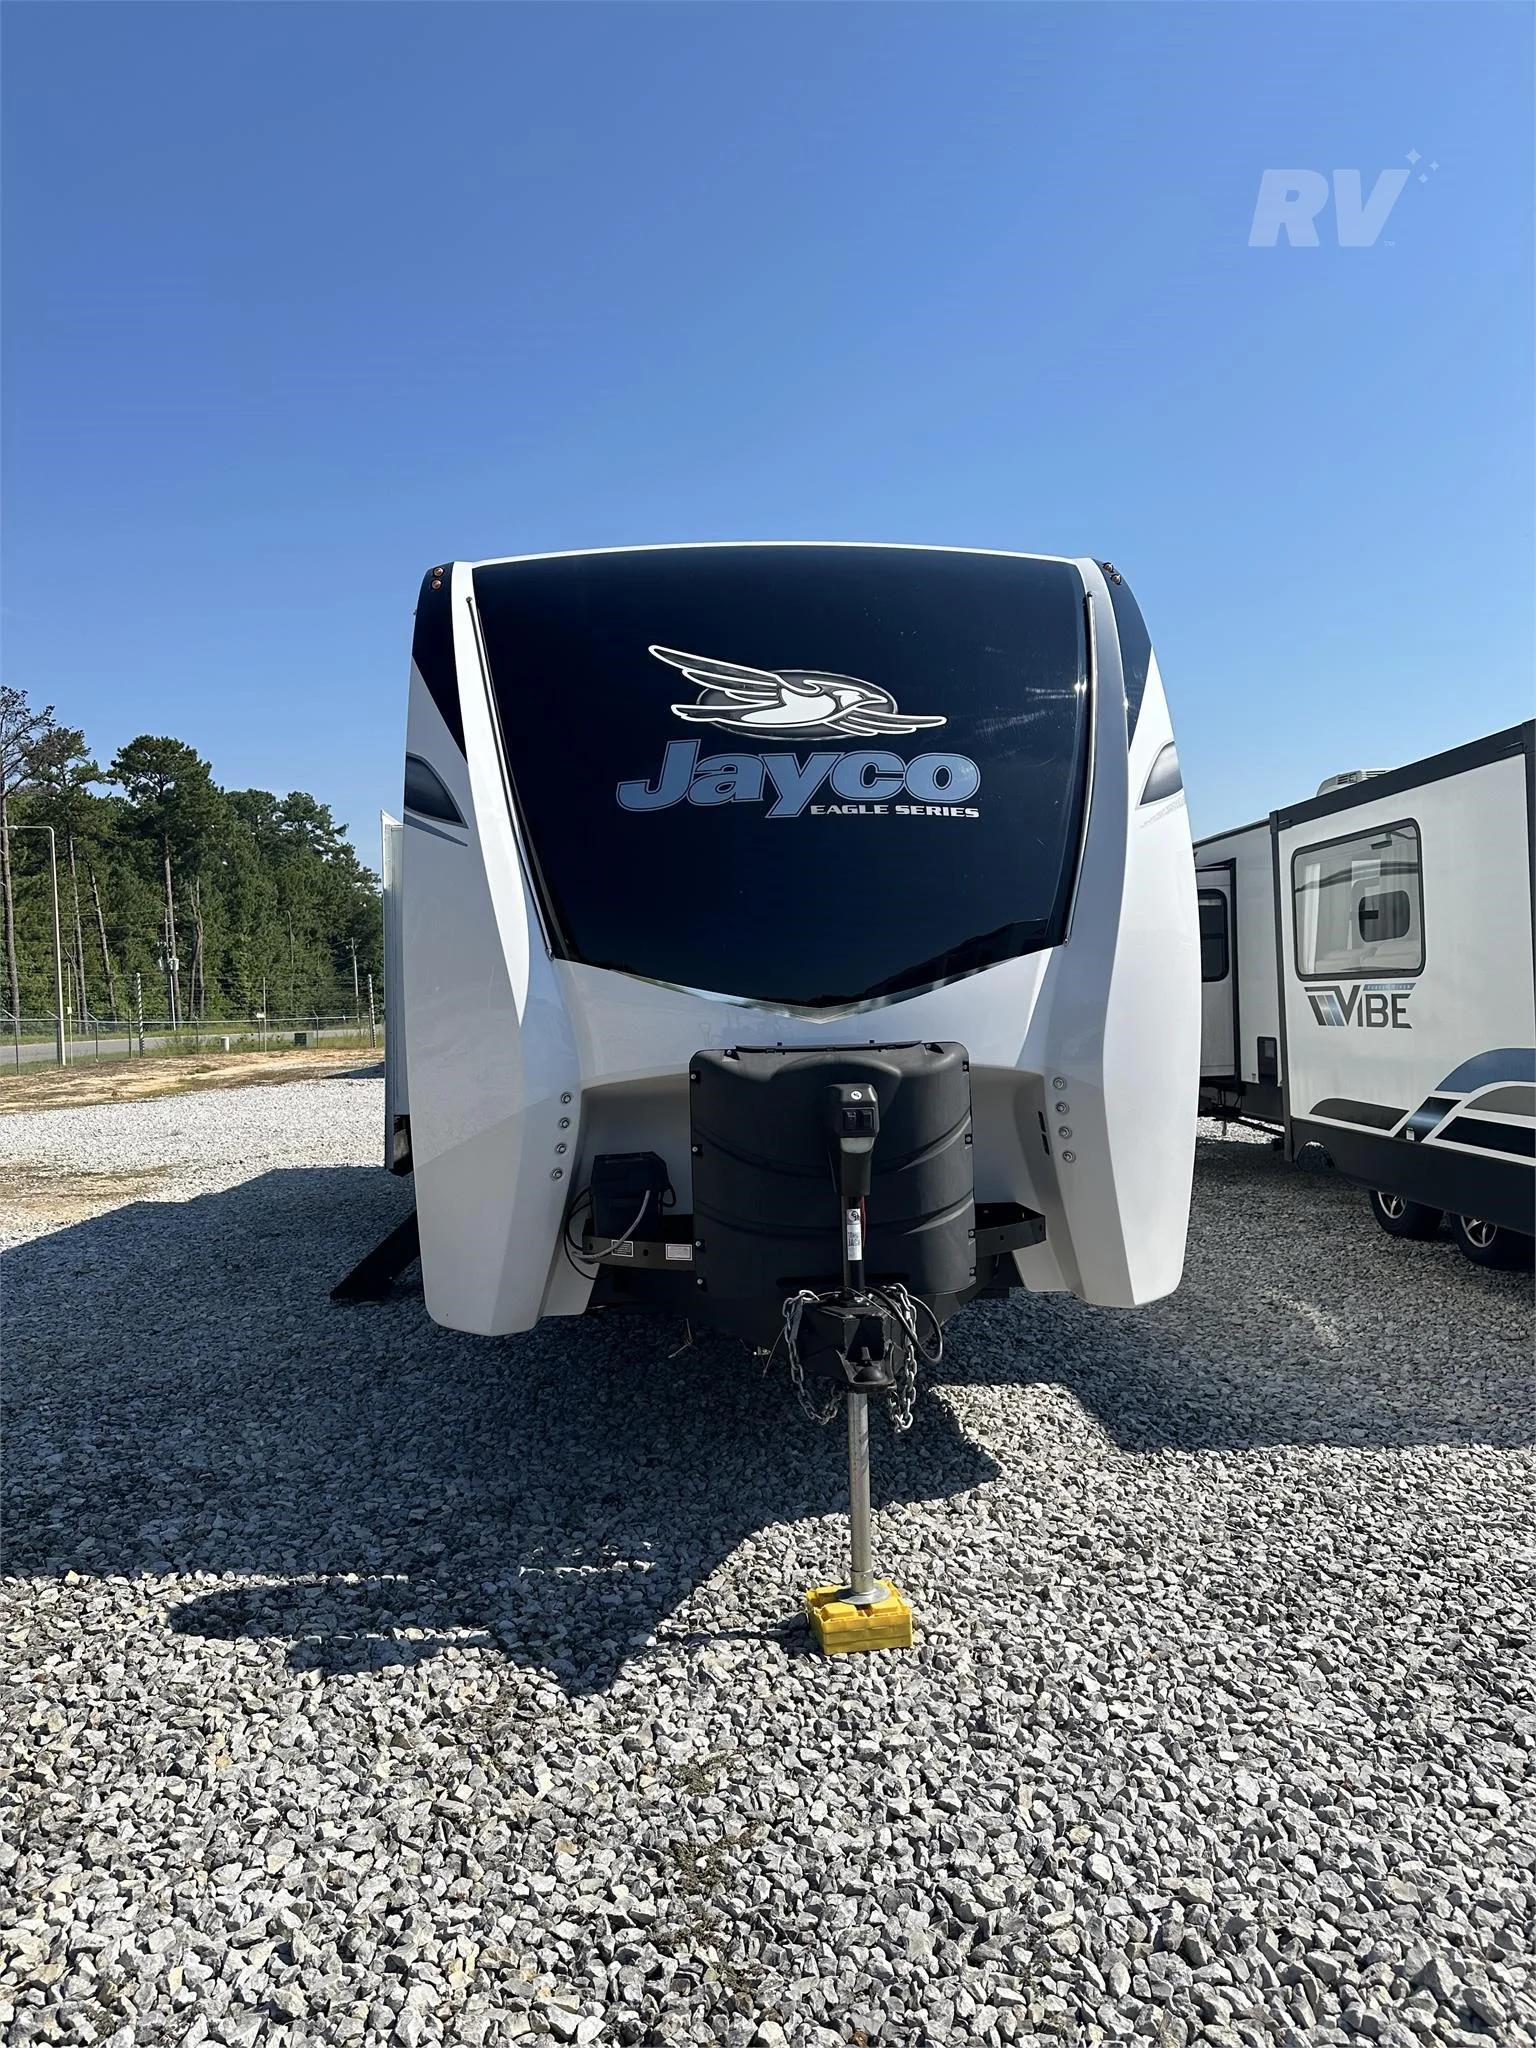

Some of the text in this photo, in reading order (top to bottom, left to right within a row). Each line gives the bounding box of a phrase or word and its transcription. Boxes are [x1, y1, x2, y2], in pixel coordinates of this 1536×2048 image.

[616, 739, 981, 818] Jayco
[810, 804, 980, 818] EAGLE SERIES
[1304, 984, 1413, 1029] VIBE
